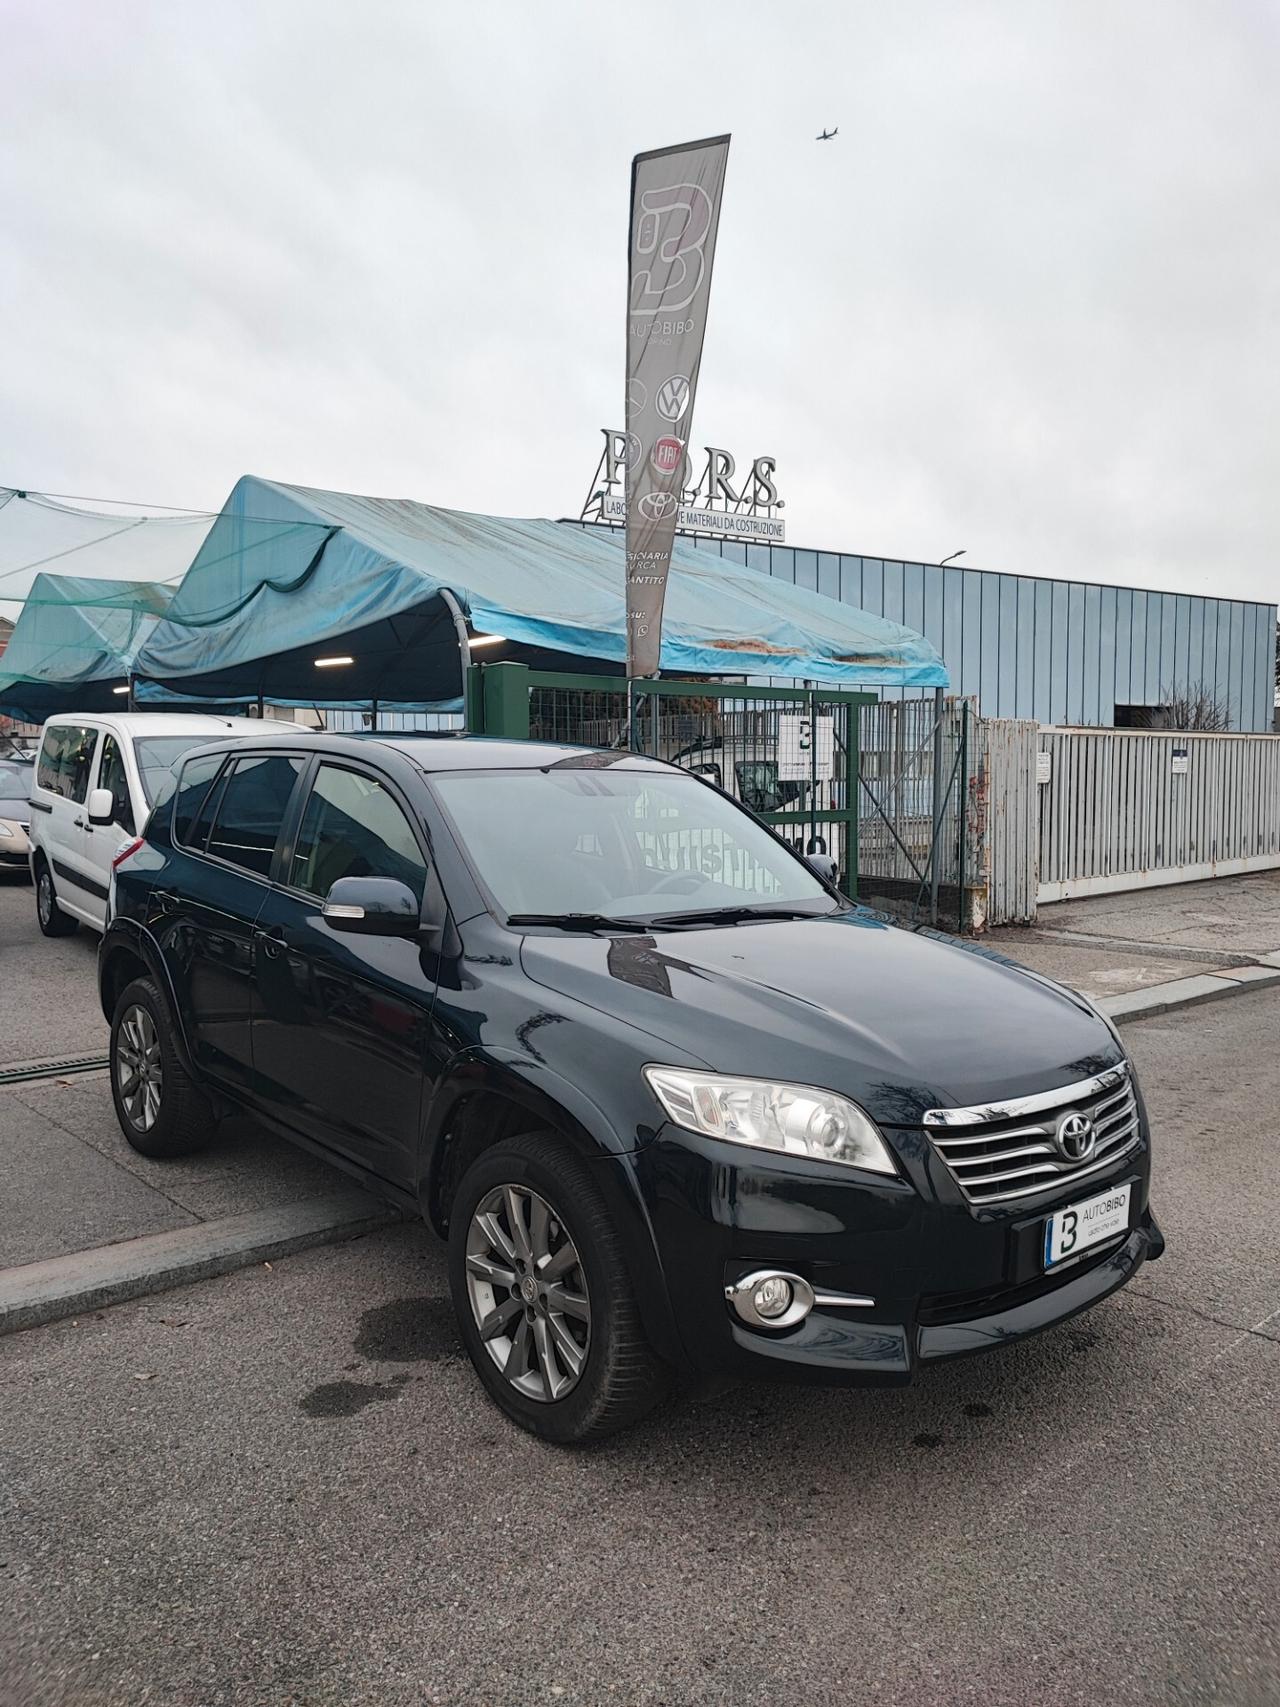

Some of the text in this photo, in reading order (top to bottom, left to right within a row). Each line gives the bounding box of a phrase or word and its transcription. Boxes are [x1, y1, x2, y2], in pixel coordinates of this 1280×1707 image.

[658, 443, 679, 466] FIAT
[686, 511, 723, 529] MATERIALI
[724, 517, 735, 530] DA
[735, 519, 783, 537] COSTRUZIONE
[1082, 1194, 1126, 1223] AUTOBIBO
